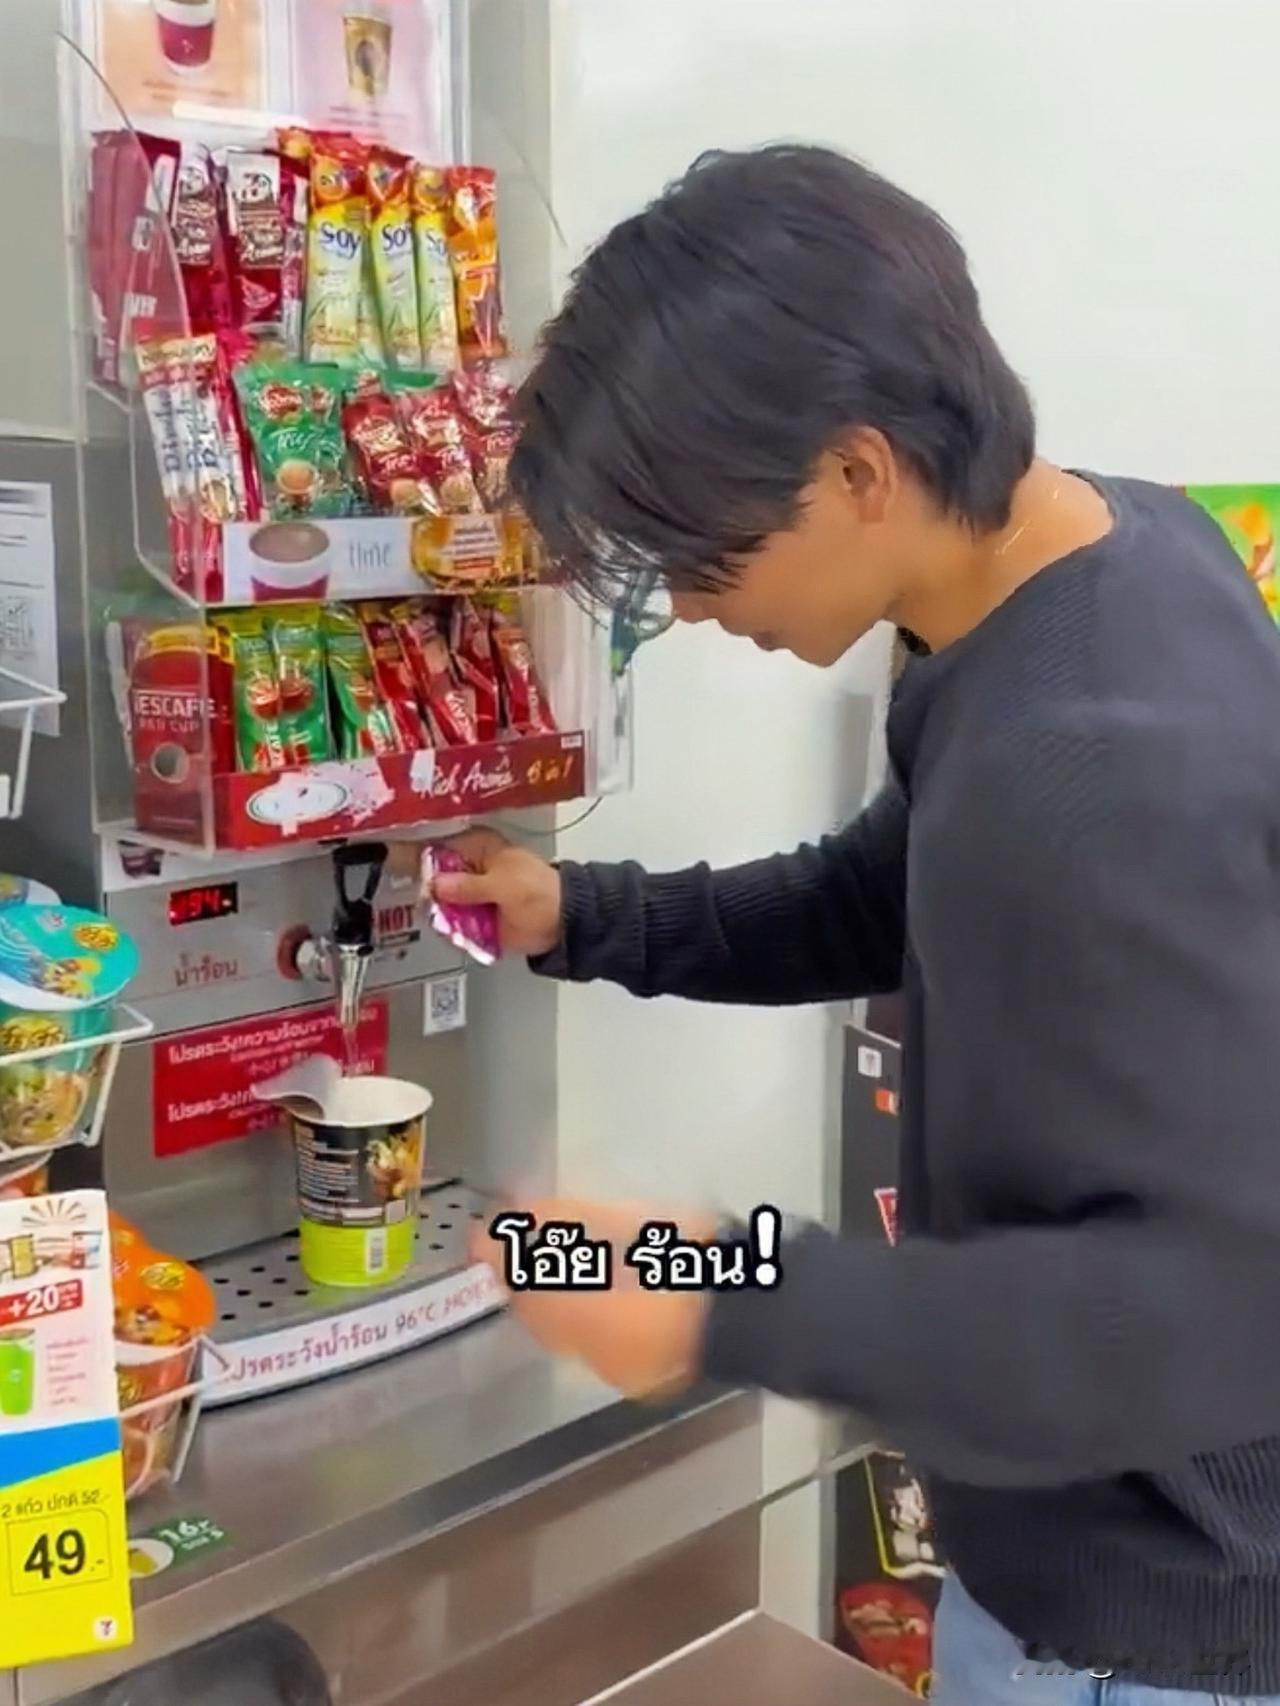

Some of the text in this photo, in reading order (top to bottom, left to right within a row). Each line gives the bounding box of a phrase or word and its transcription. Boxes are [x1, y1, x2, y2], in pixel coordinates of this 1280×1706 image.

[319, 222, 361, 258] Soy
[378, 903, 416, 933] HOT
[8, 1284, 61, 1318] +20
[229, 1321, 388, 1381] ปรดระวังน้ำร้อน
